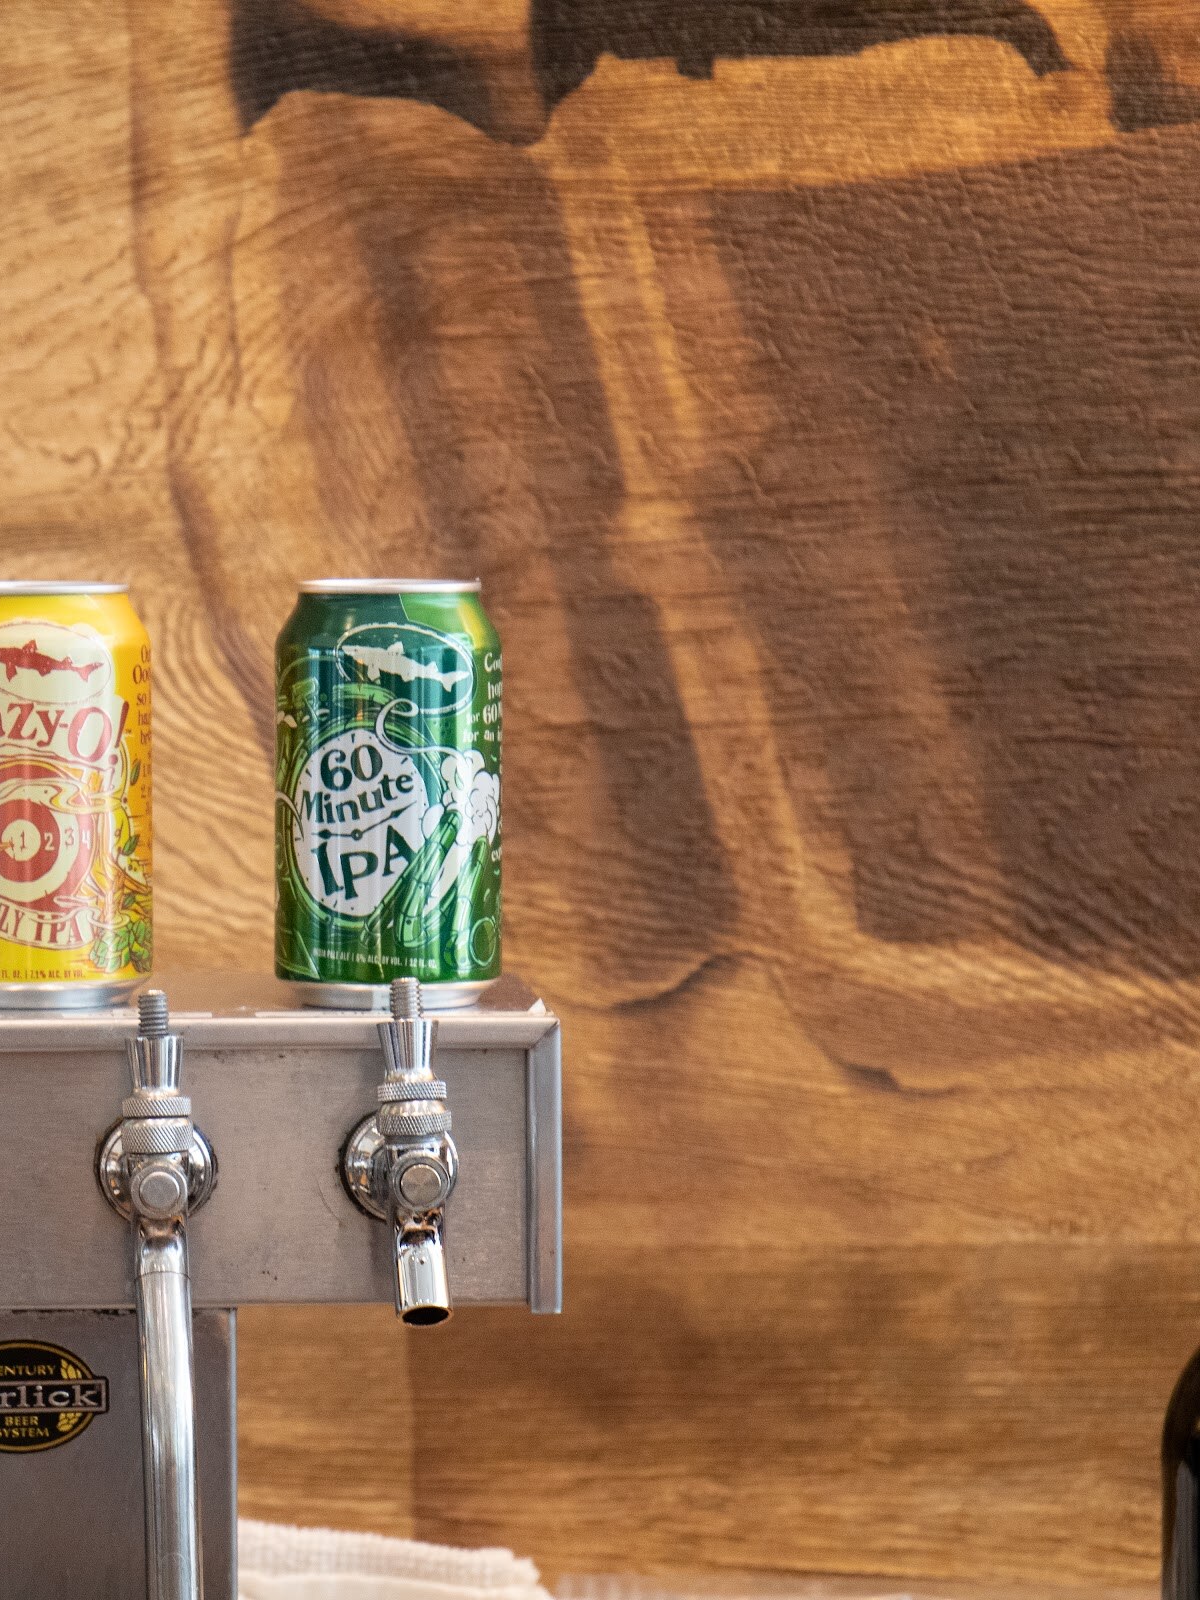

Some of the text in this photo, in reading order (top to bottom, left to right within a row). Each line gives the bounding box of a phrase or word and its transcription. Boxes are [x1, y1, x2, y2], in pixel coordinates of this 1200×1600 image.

[320, 744, 383, 791] 60
[300, 771, 415, 824] Minute
[19, 827, 91, 851] 1 2 3 4
[311, 825, 416, 900] IPA
[34, 911, 84, 944] IPA
[4, 1416, 39, 1426] BEER
